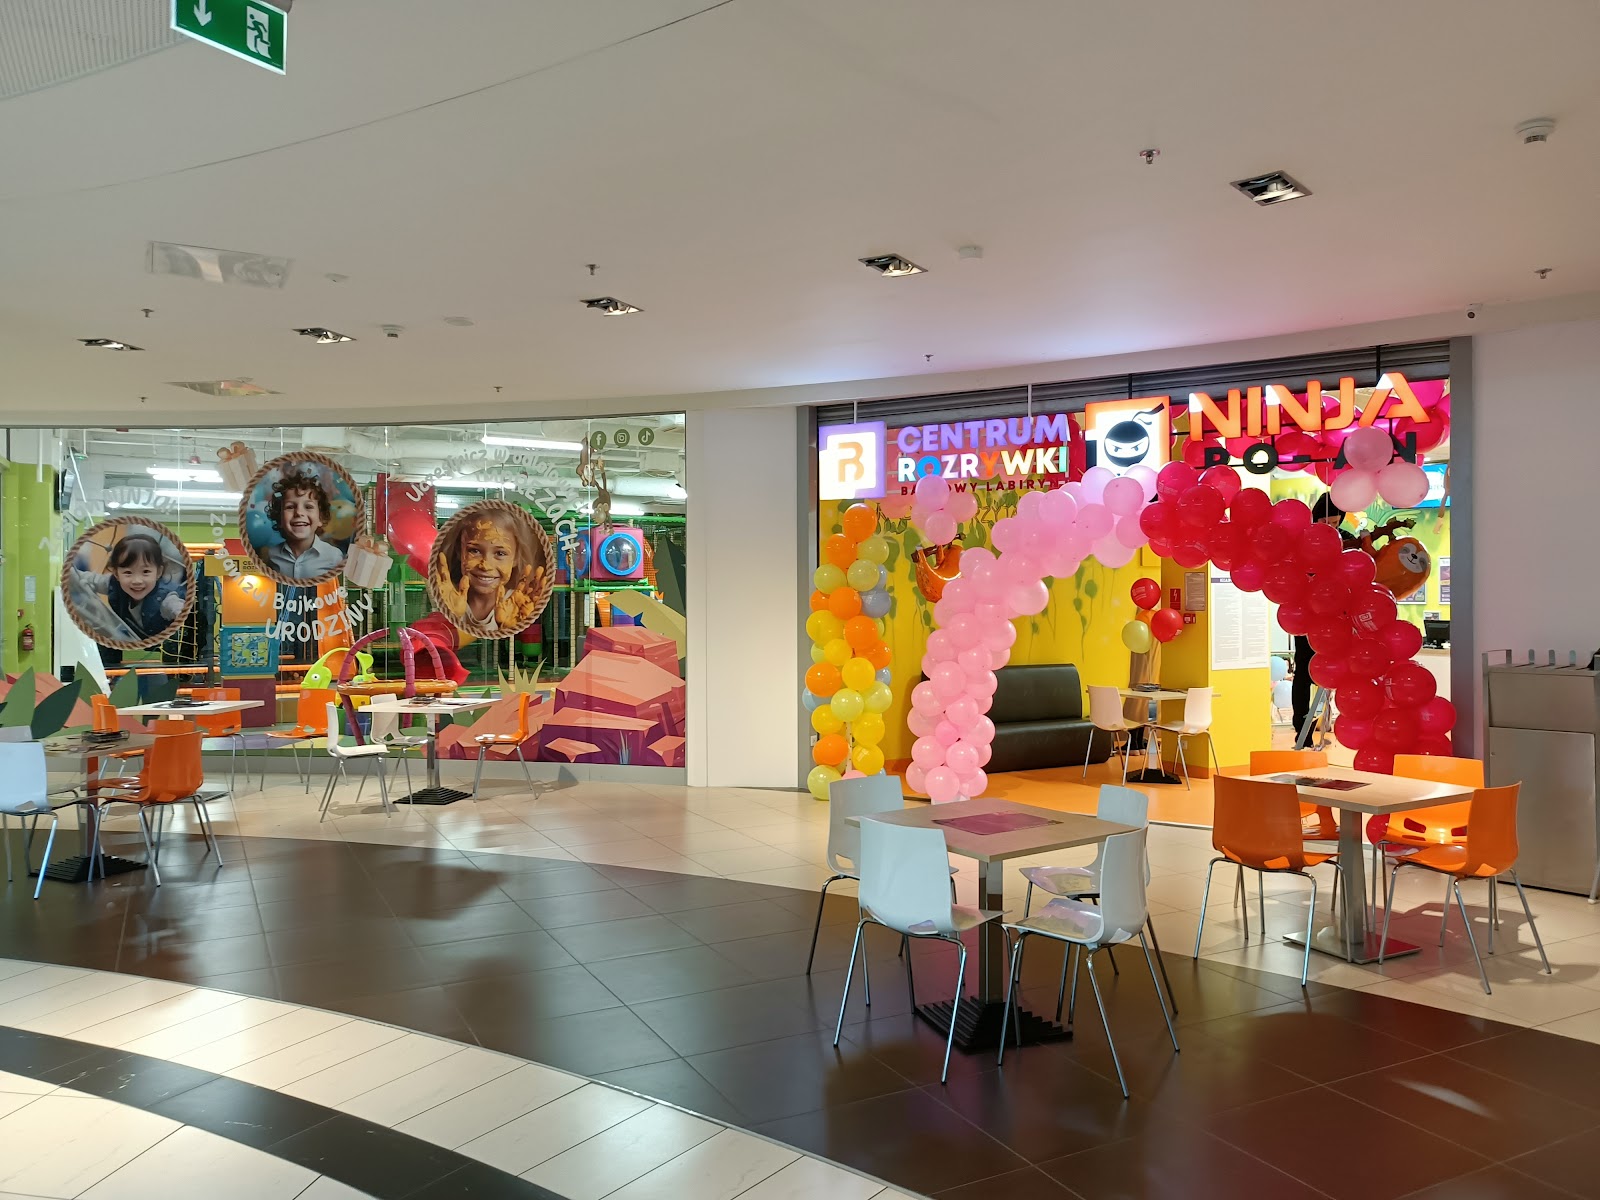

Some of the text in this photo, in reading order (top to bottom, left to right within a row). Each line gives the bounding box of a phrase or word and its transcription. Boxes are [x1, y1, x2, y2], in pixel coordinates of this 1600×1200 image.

[1188, 372, 1431, 441] NINJA
[897, 413, 1071, 454] CENTRUM
[897, 446, 1069, 482] ROZRYWKI
[265, 593, 374, 643] URODZINY
[273, 586, 348, 616] Bajkowe
